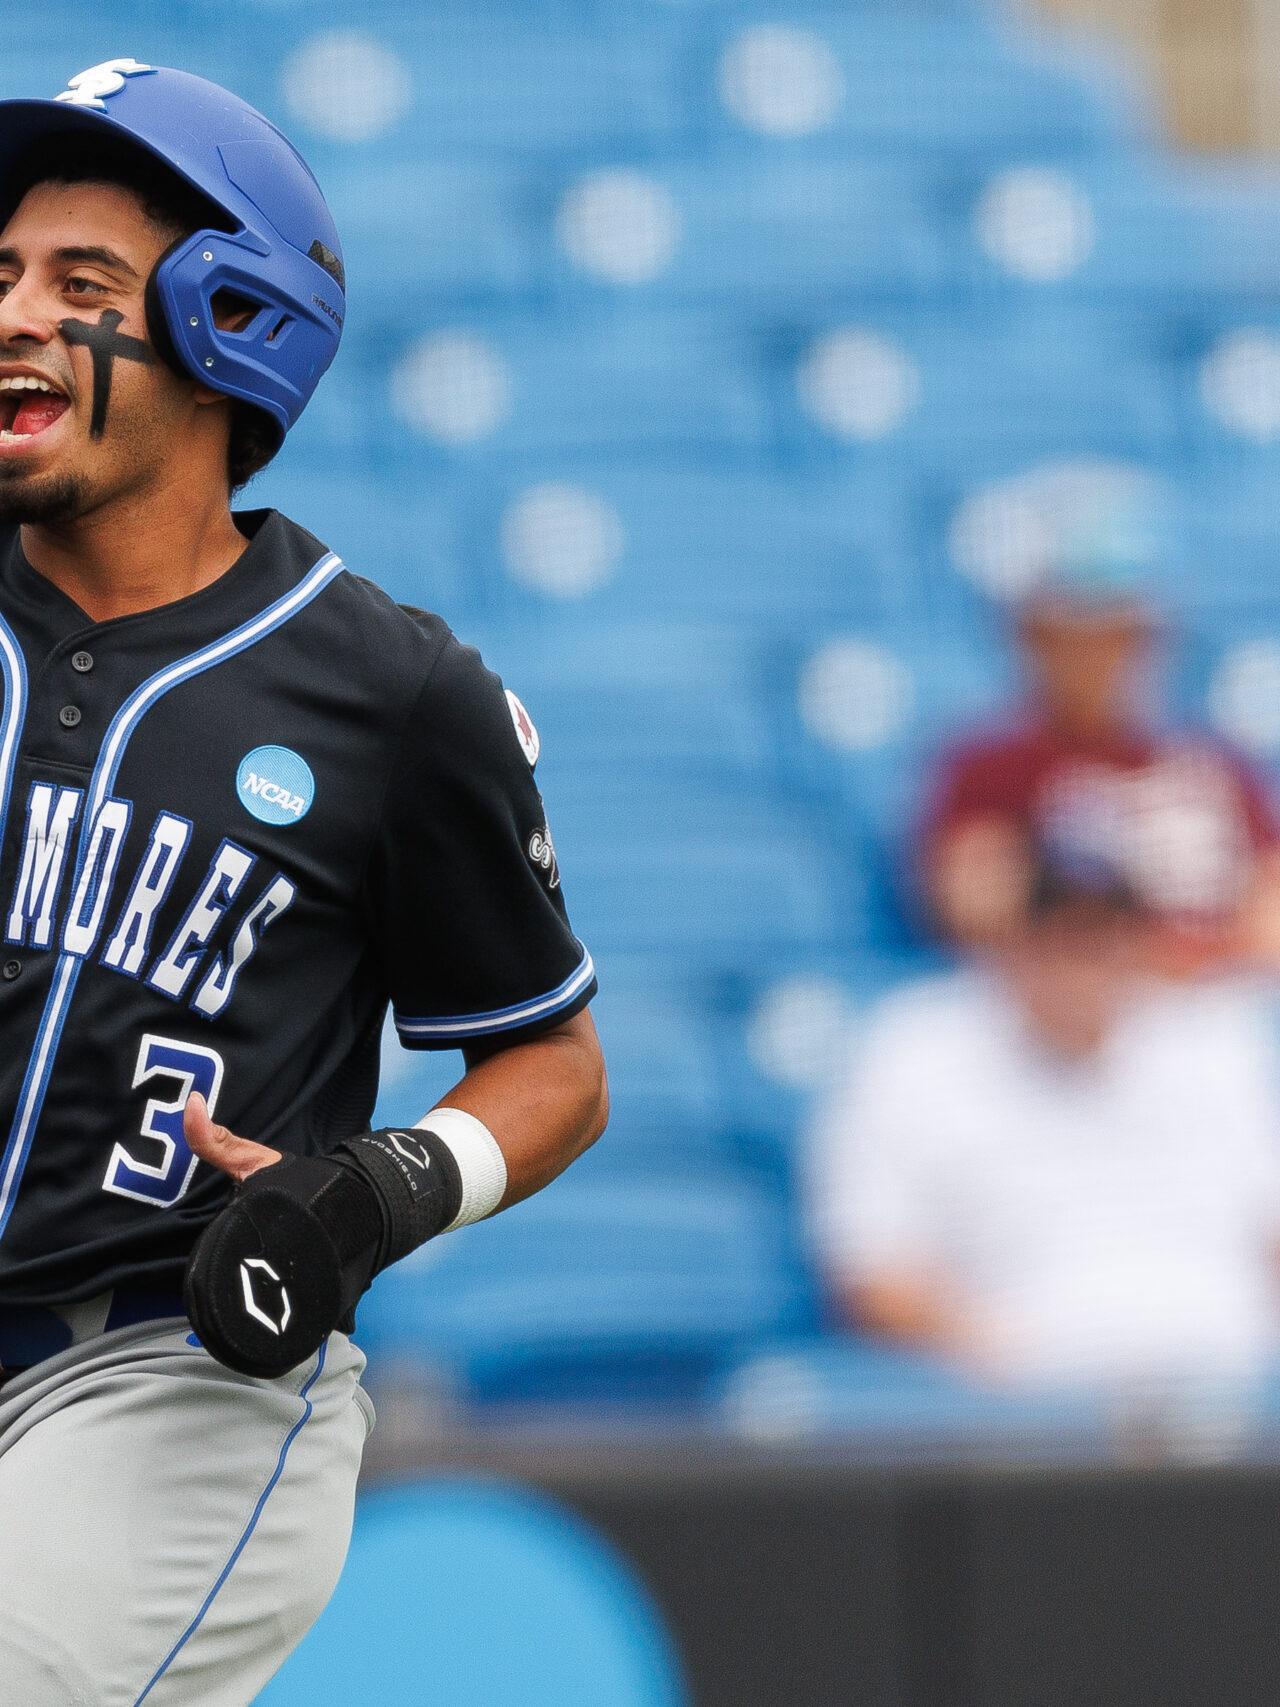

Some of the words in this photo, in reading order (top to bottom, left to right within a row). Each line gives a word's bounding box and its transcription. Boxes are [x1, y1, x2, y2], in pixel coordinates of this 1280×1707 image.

[242, 772, 306, 817] NCAA
[102, 1033, 224, 1208] 3
[361, 1138, 417, 1191] EVOSHIELD
